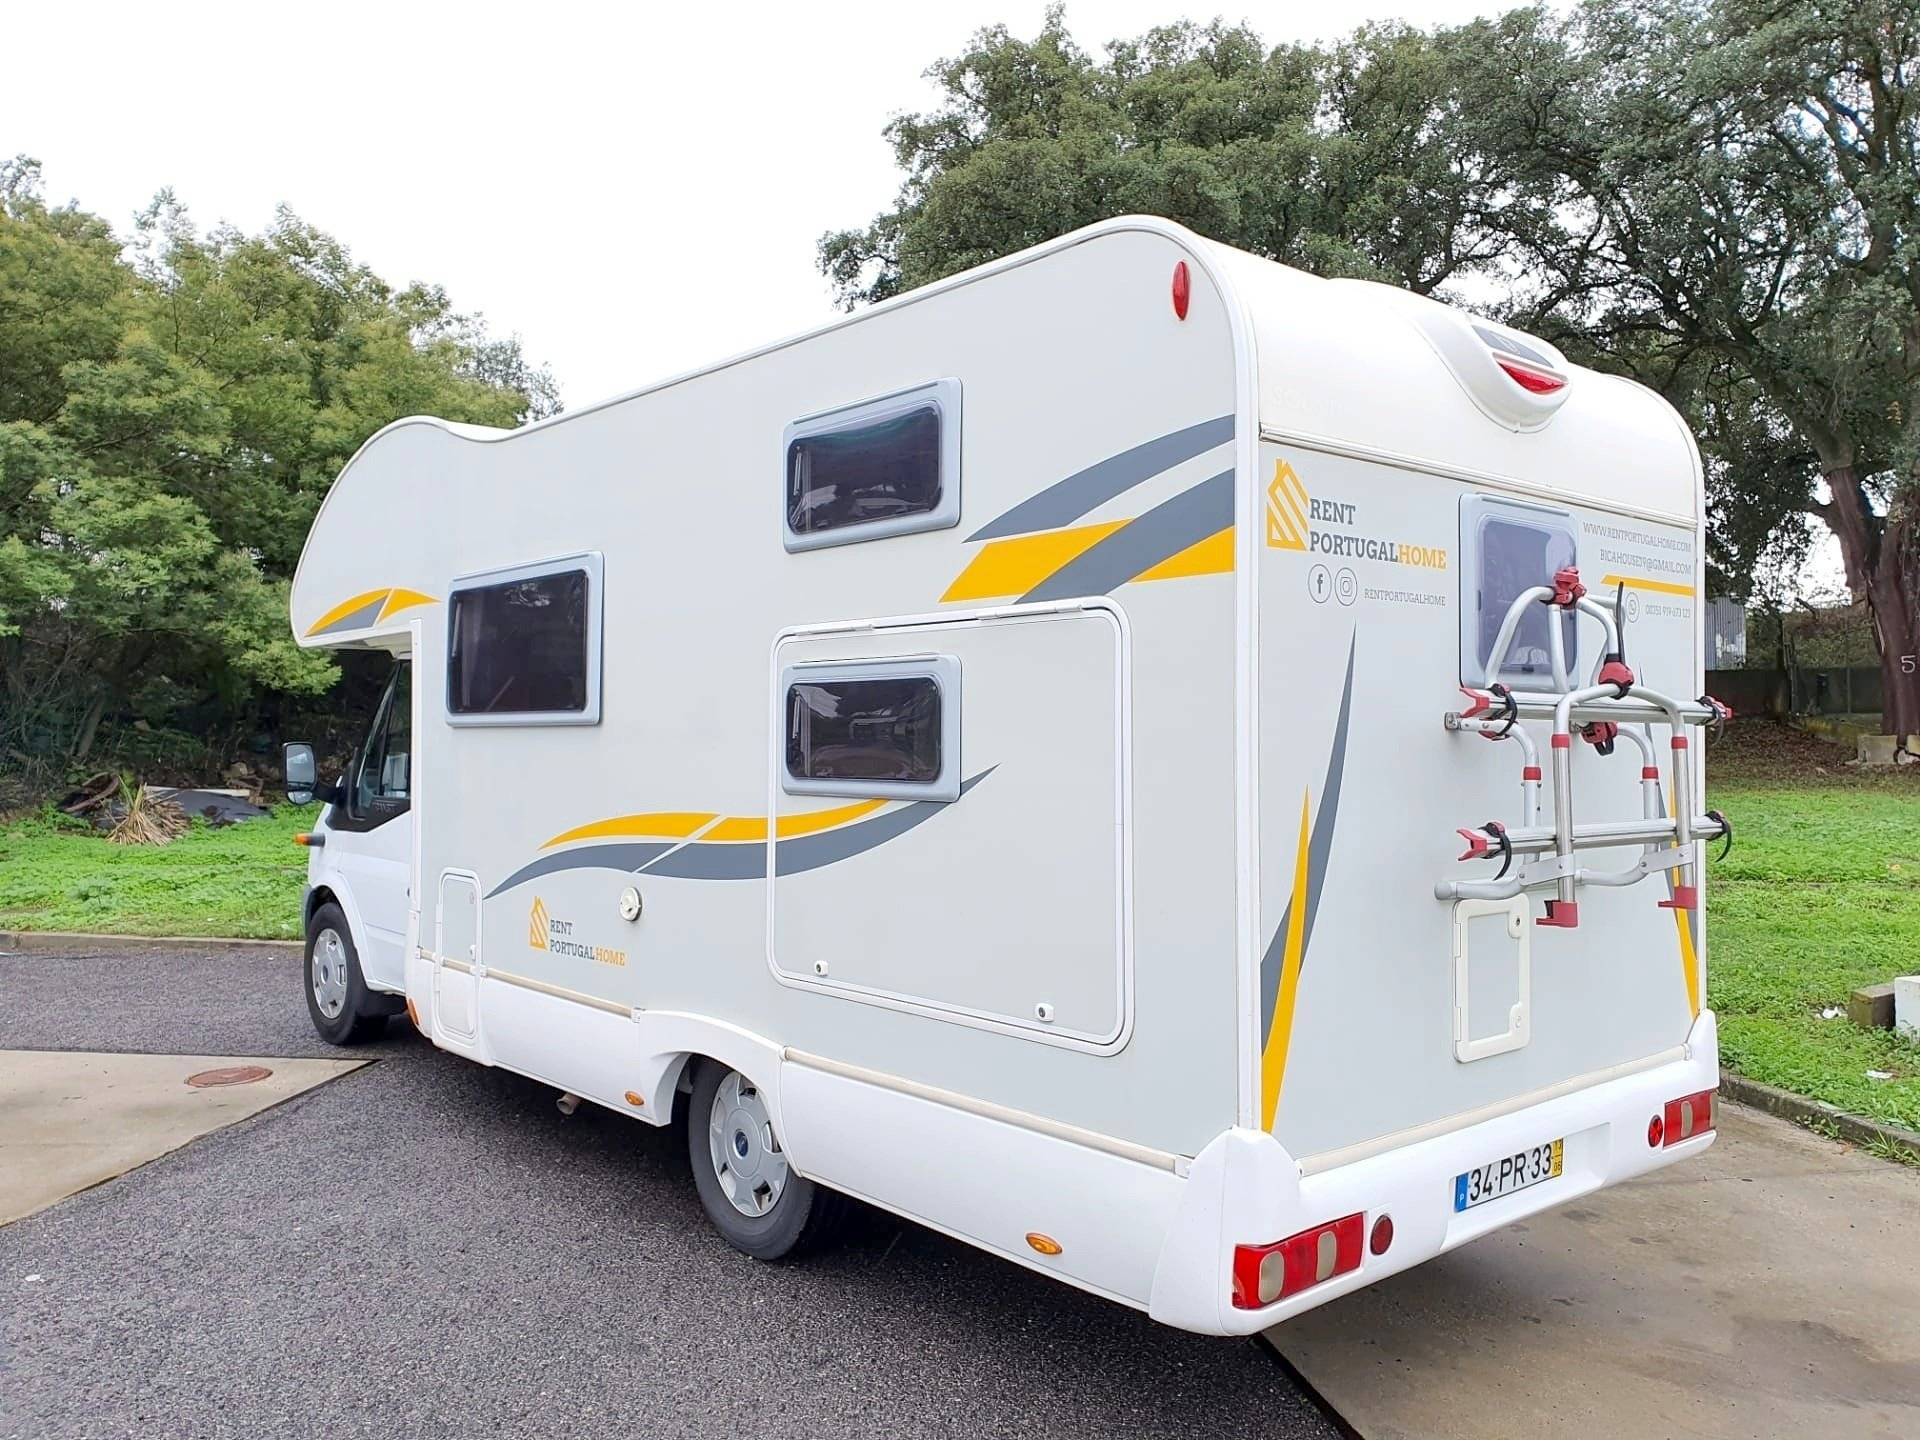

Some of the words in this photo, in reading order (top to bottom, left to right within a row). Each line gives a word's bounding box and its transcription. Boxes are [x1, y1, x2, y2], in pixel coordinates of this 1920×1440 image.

[1310, 498, 1356, 525] RENT
[1310, 530, 1447, 570] PORTUGALHOME
[1364, 588, 1446, 607] RENTPORTUGALHOME
[1901, 655, 1916, 674] 5
[550, 919, 573, 936] RENT
[549, 939, 625, 967] PORTUGALHOME
